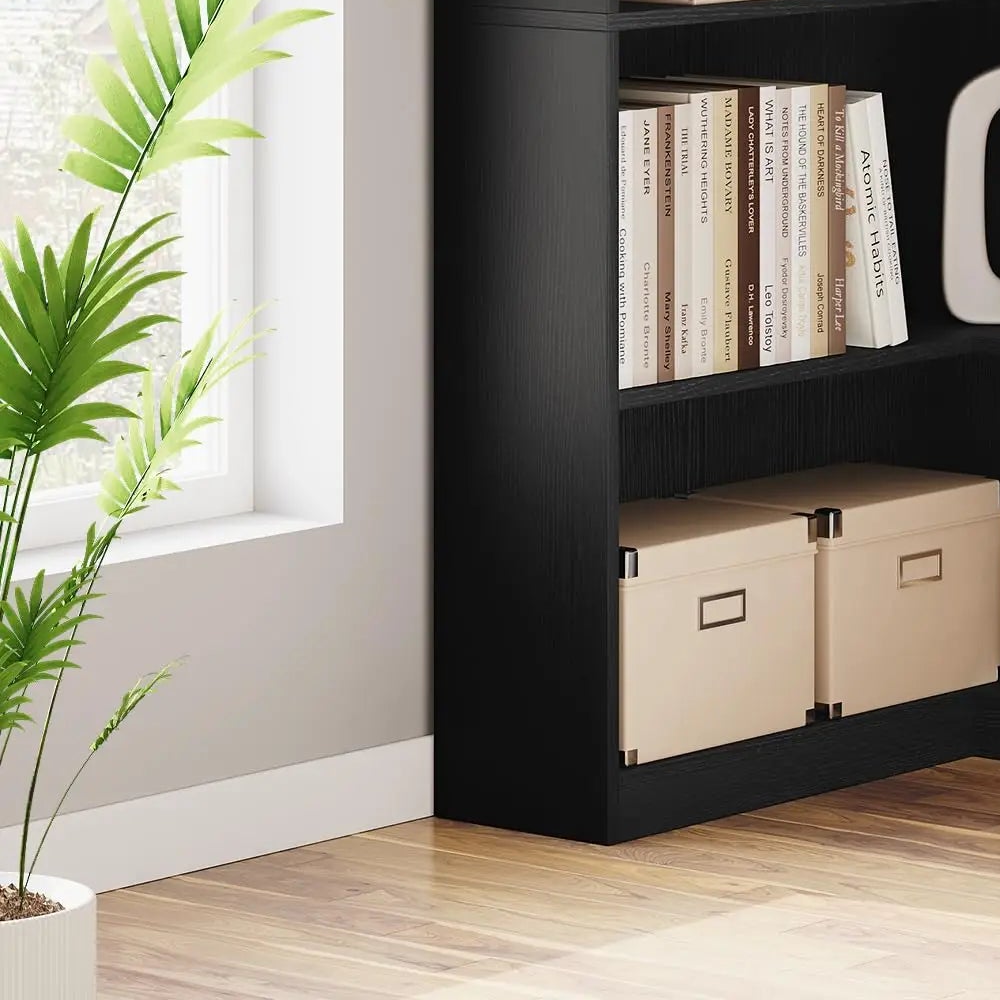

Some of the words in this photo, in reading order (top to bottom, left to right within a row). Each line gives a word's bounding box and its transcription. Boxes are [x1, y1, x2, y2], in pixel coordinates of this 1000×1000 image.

[724, 97, 733, 157] MADAME
[765, 100, 774, 137] WHAT
[798, 105, 806, 120] THE
[817, 103, 825, 132] HEART
[835, 109, 845, 122] To
[643, 119, 651, 155] JANE
[681, 128, 689, 146] THE
[765, 141, 774, 154] IS
[798, 124, 807, 156] HOUND
[817, 135, 825, 147] OF
[835, 125, 845, 142] Kill
[643, 159, 651, 196] EYER
[664, 113, 672, 218] FRANKENSTEIN
[681, 149, 689, 176] TRIAL
[765, 157, 774, 183] ART
[798, 158, 807, 170] OF
[817, 149, 825, 198] DARKNESS
[724, 162, 733, 214] BOVARY
[798, 173, 807, 190] THE
[832, 153, 845, 211] Mockingbird
[798, 192, 807, 257] BASKERVILLES
[861, 150, 877, 224] Atomic
[870, 231, 885, 298] Habits
[618, 228, 627, 279] Cooking
[724, 258, 733, 307] Gustave
[780, 257, 789, 285] Fyodor
[619, 282, 628, 308] with
[643, 262, 652, 321] Charlotte
[765, 284, 774, 307] Leo
[816, 272, 825, 302] Joseph
[832, 278, 844, 311] Harper
[664, 291, 672, 322] Mary
[699, 297, 708, 325] Emily
[817, 304, 825, 333] Conrad
[619, 312, 628, 365] Pomiane
[724, 311, 733, 362] Flaubert
[763, 310, 774, 353] Tolstoy
[834, 314, 844, 332] Lee
[643, 326, 652, 369] Bronte
[664, 325, 672, 370] Shelley
[681, 329, 689, 354] Kafka
